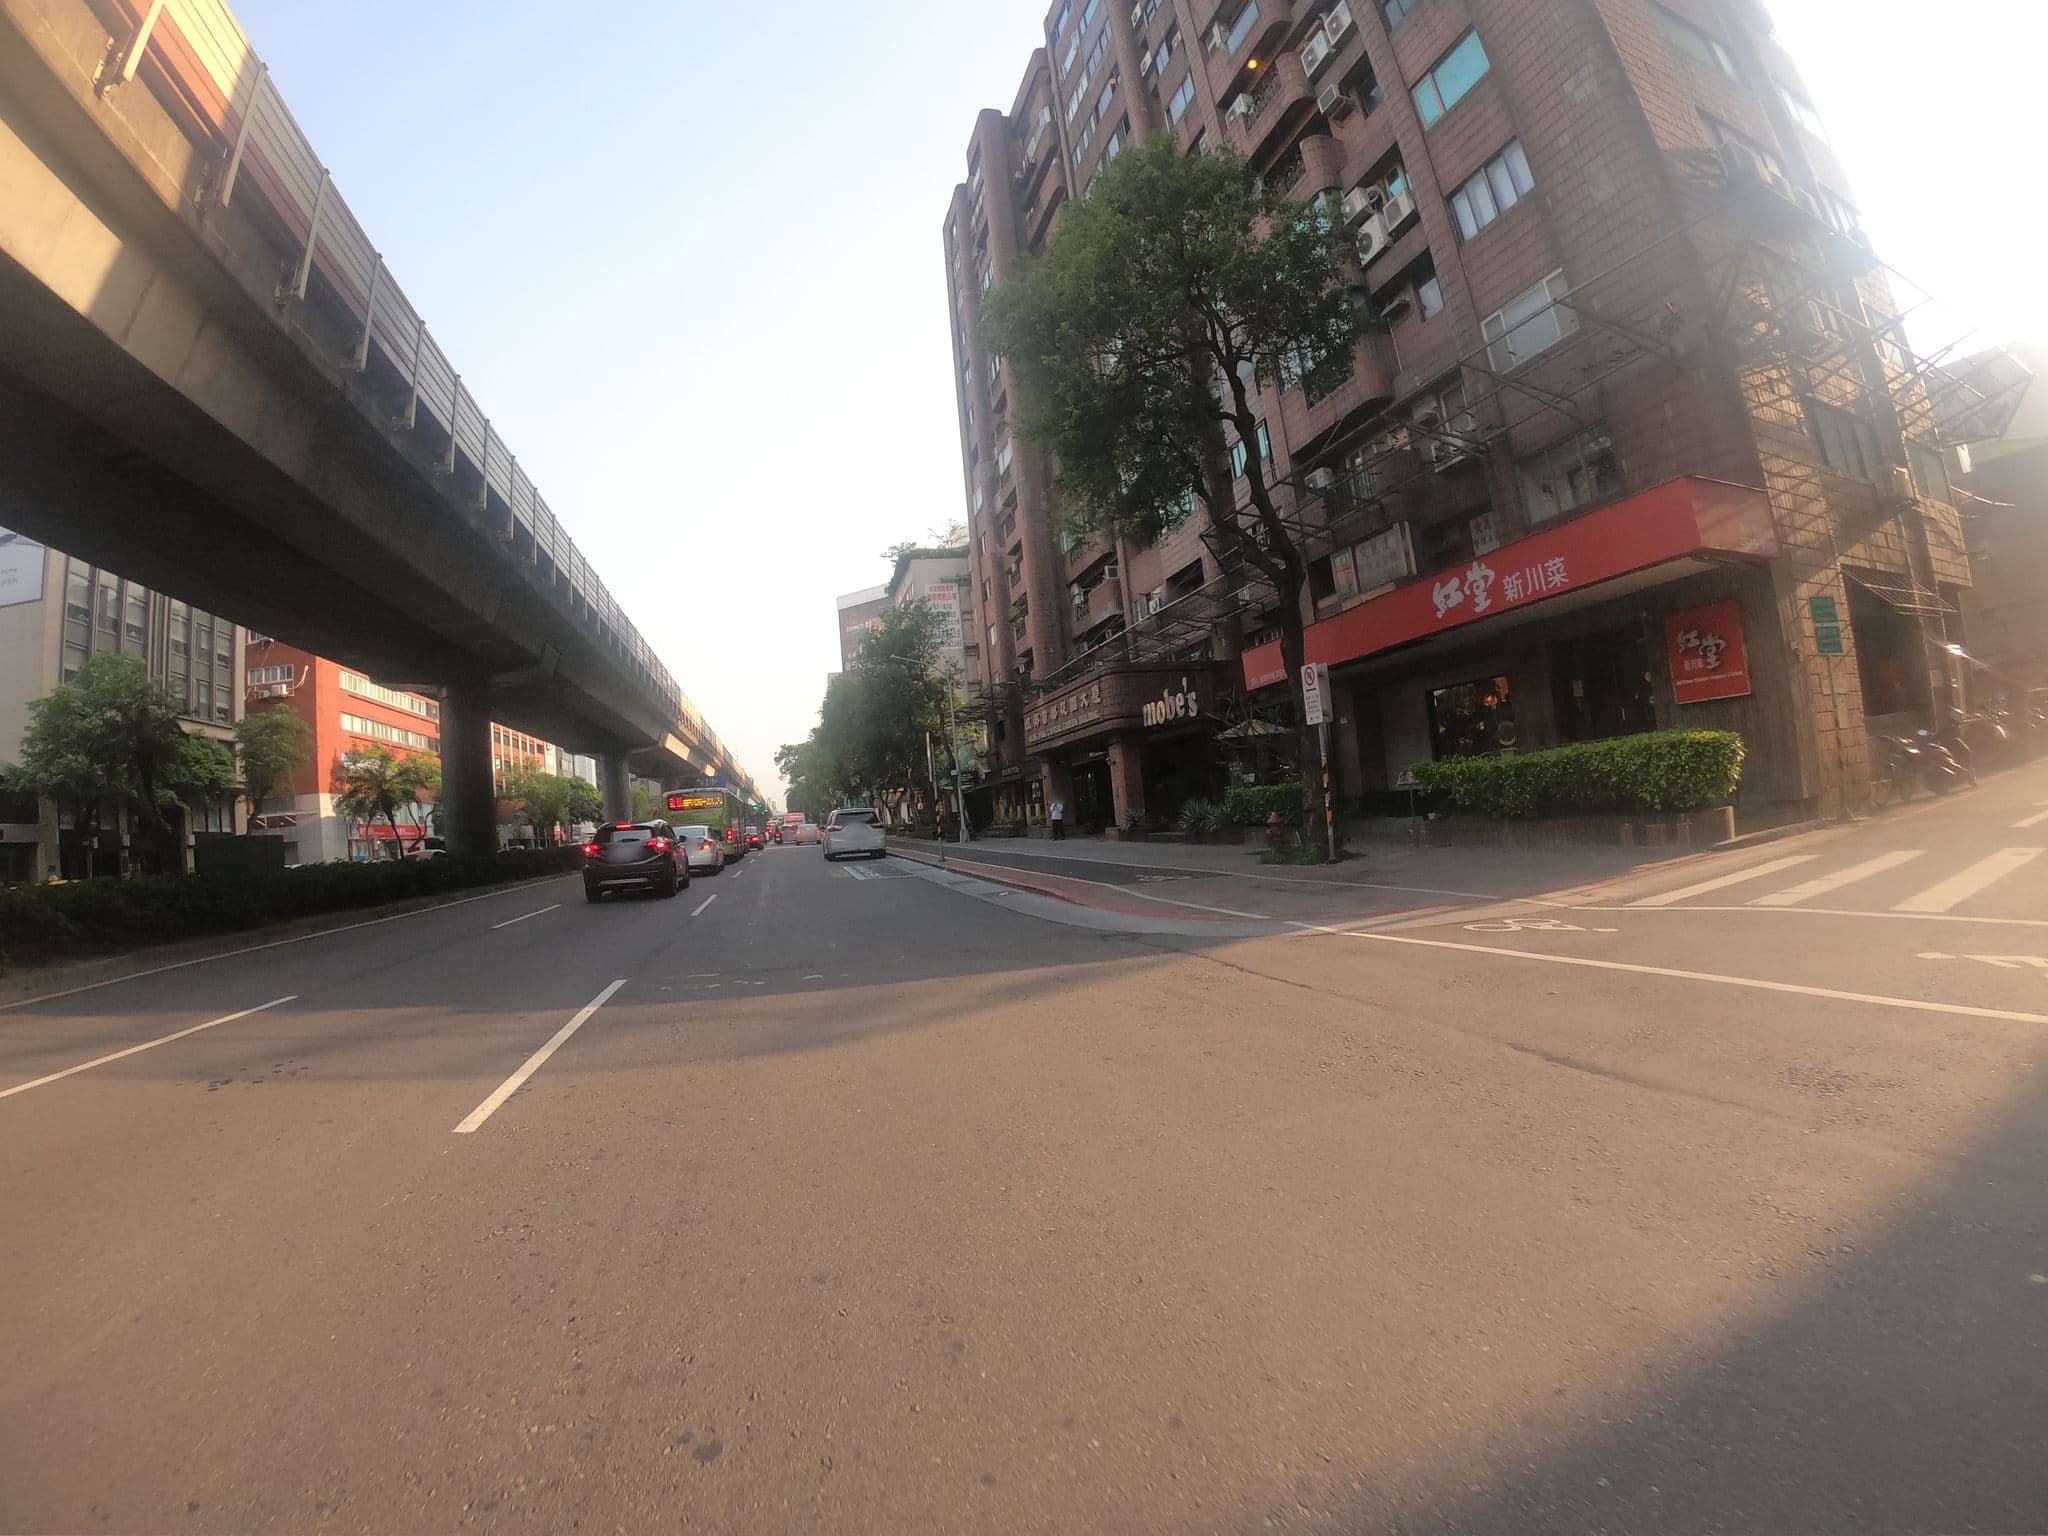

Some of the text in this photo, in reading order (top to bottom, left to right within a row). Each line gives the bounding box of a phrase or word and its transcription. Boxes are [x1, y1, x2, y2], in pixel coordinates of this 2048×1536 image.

[1502, 557, 1570, 602] 新川菜
[1141, 676, 1199, 728] mobe's
